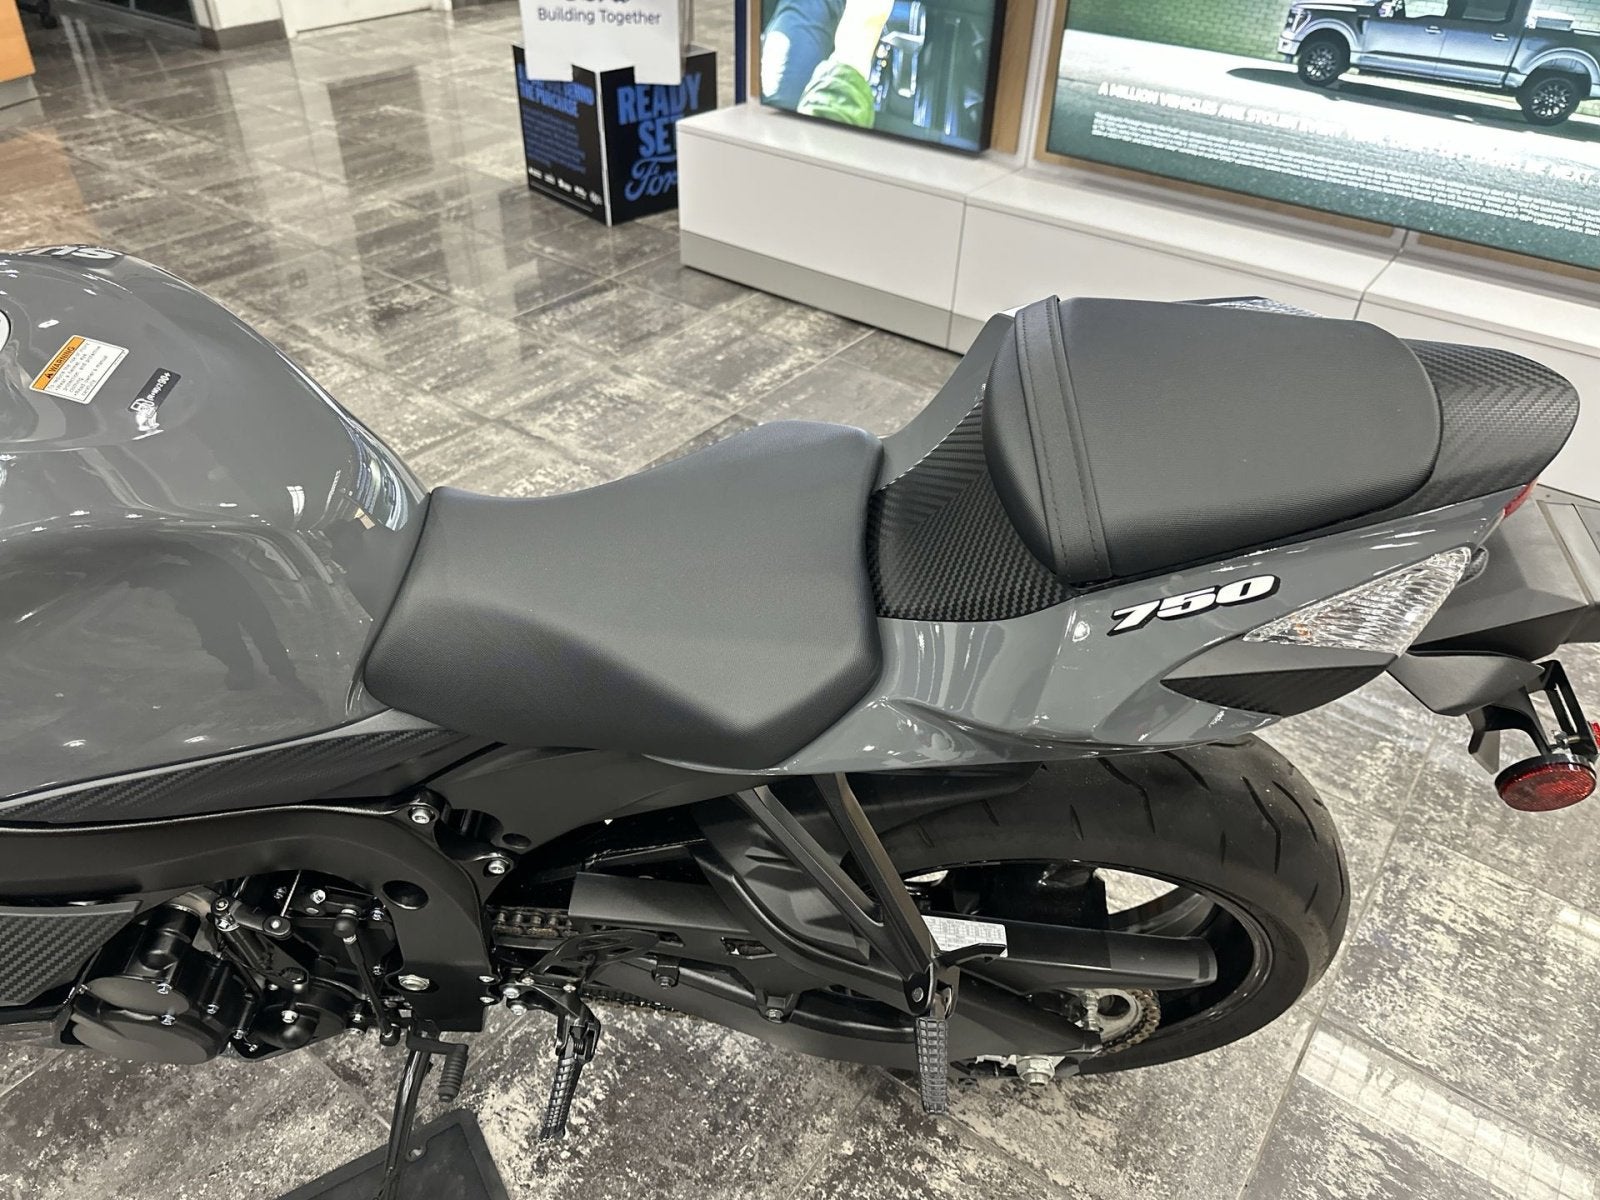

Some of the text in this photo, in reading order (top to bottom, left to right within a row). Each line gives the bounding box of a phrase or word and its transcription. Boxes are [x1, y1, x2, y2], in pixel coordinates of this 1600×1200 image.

[538, 8, 661, 26] Building Together
[616, 72, 700, 126] READY
[1109, 82, 1160, 105] MILLION
[624, 156, 678, 202] For
[50, 345, 75, 372] WARNING
[1107, 574, 1281, 636] 750
